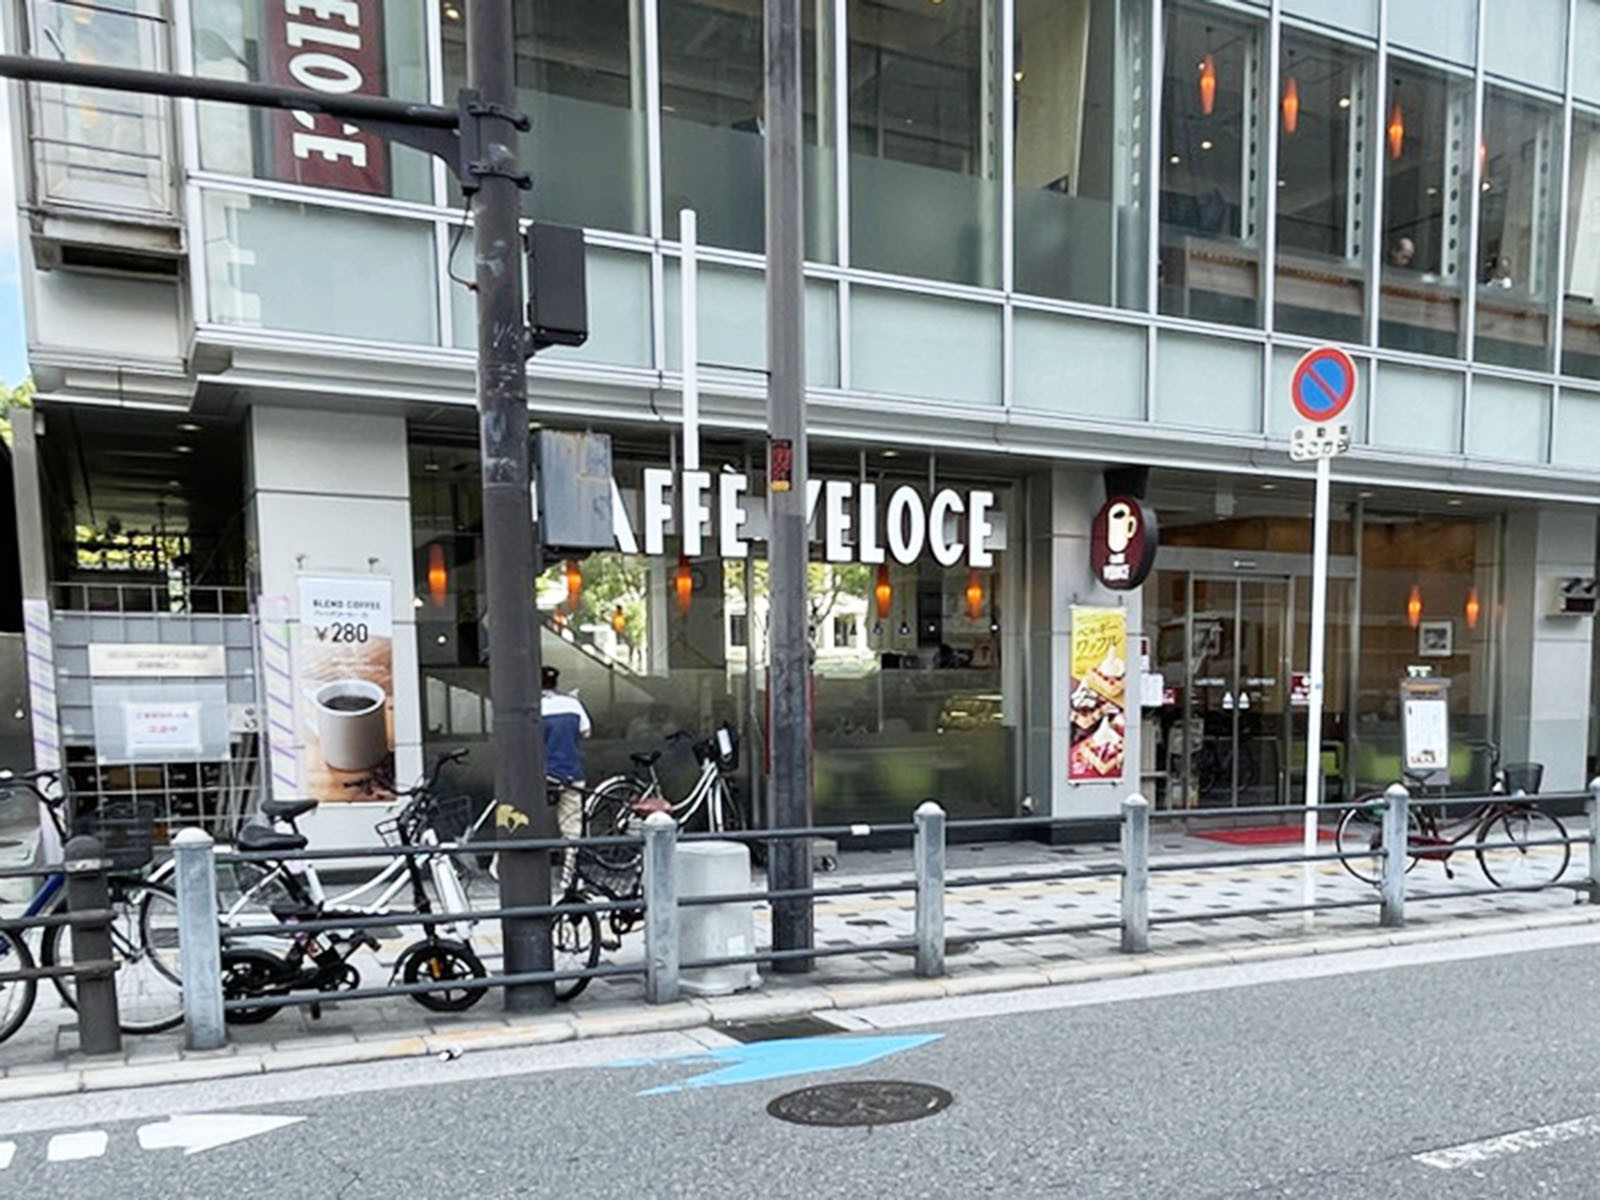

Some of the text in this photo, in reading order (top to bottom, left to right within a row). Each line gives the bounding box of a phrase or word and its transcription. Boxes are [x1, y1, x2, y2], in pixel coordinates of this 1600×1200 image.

[285, 0, 367, 168] ELOE
[312, 599, 381, 611] BLEND COFFEE
